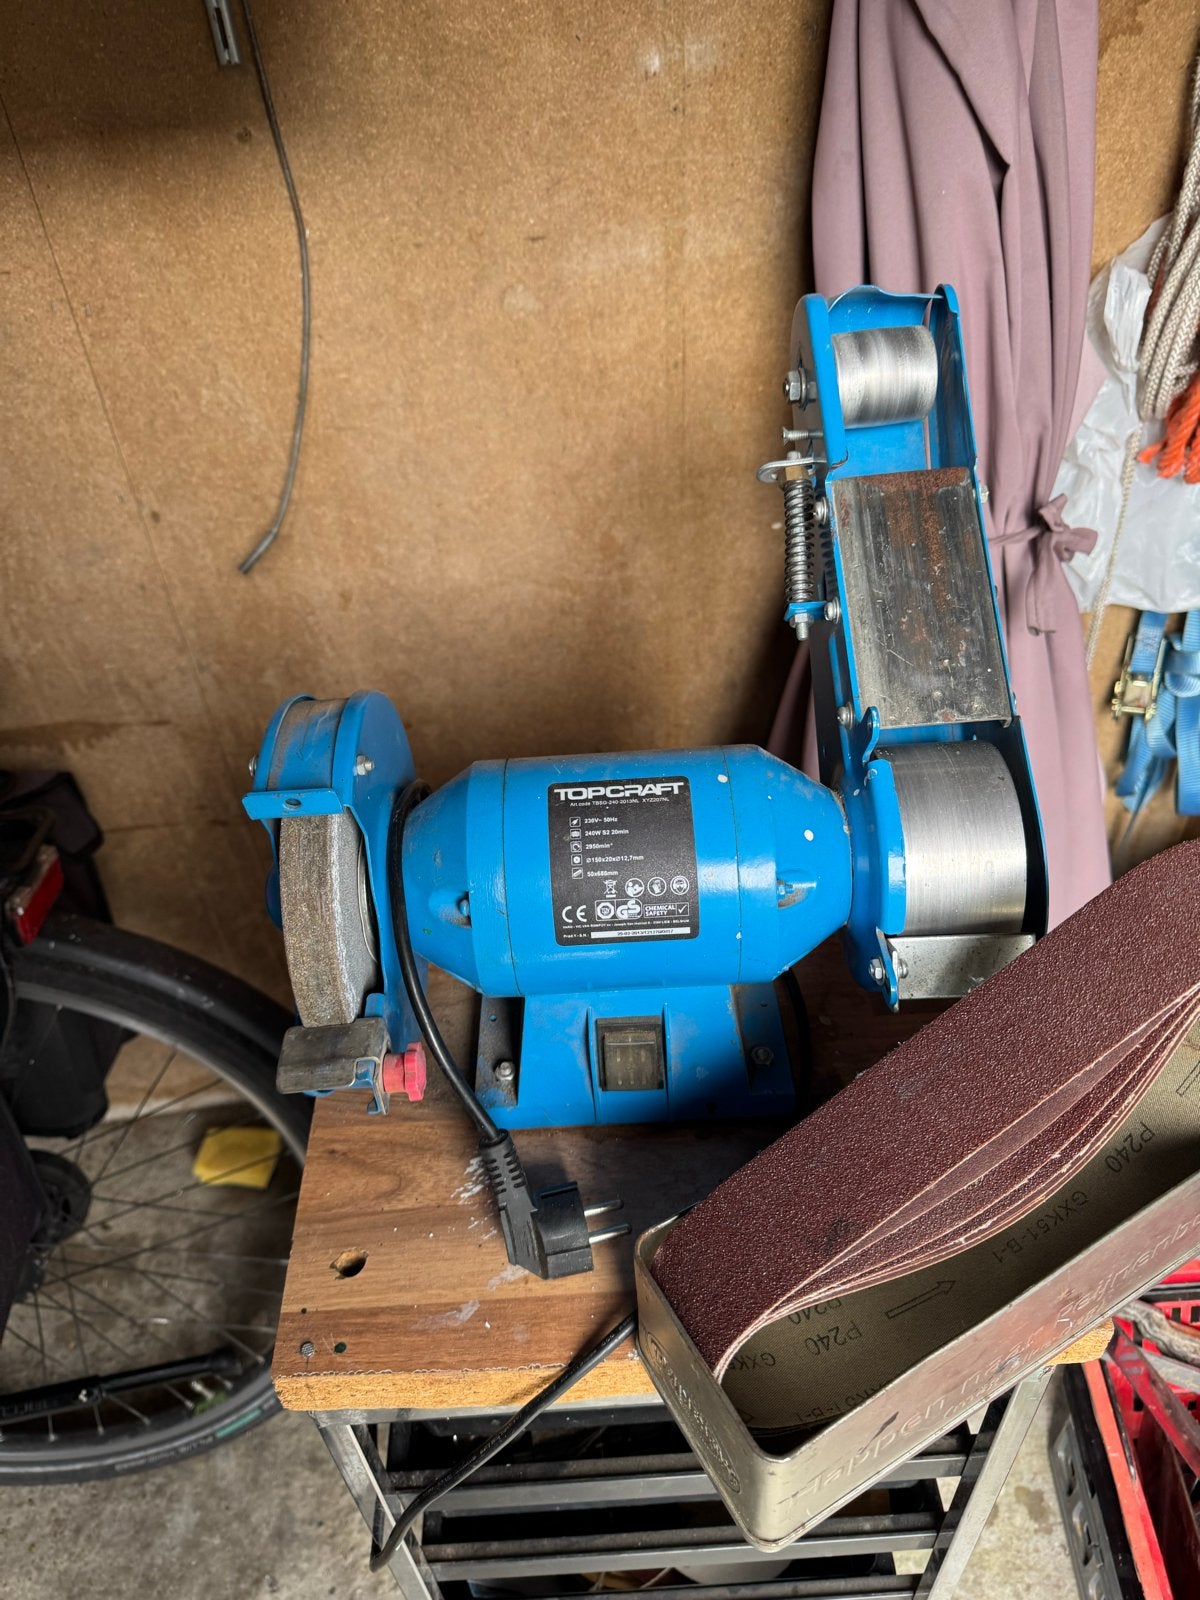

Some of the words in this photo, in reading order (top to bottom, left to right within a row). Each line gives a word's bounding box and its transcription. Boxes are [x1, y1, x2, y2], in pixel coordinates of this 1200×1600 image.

[554, 782, 684, 801] TOPCRAFT
[562, 904, 588, 923] CE
[645, 904, 676, 912] CHEMICAL
[1104, 1121, 1156, 1174] P240
[991, 1190, 1089, 1264] GXK51-B-1
[804, 1320, 863, 1356] P240
